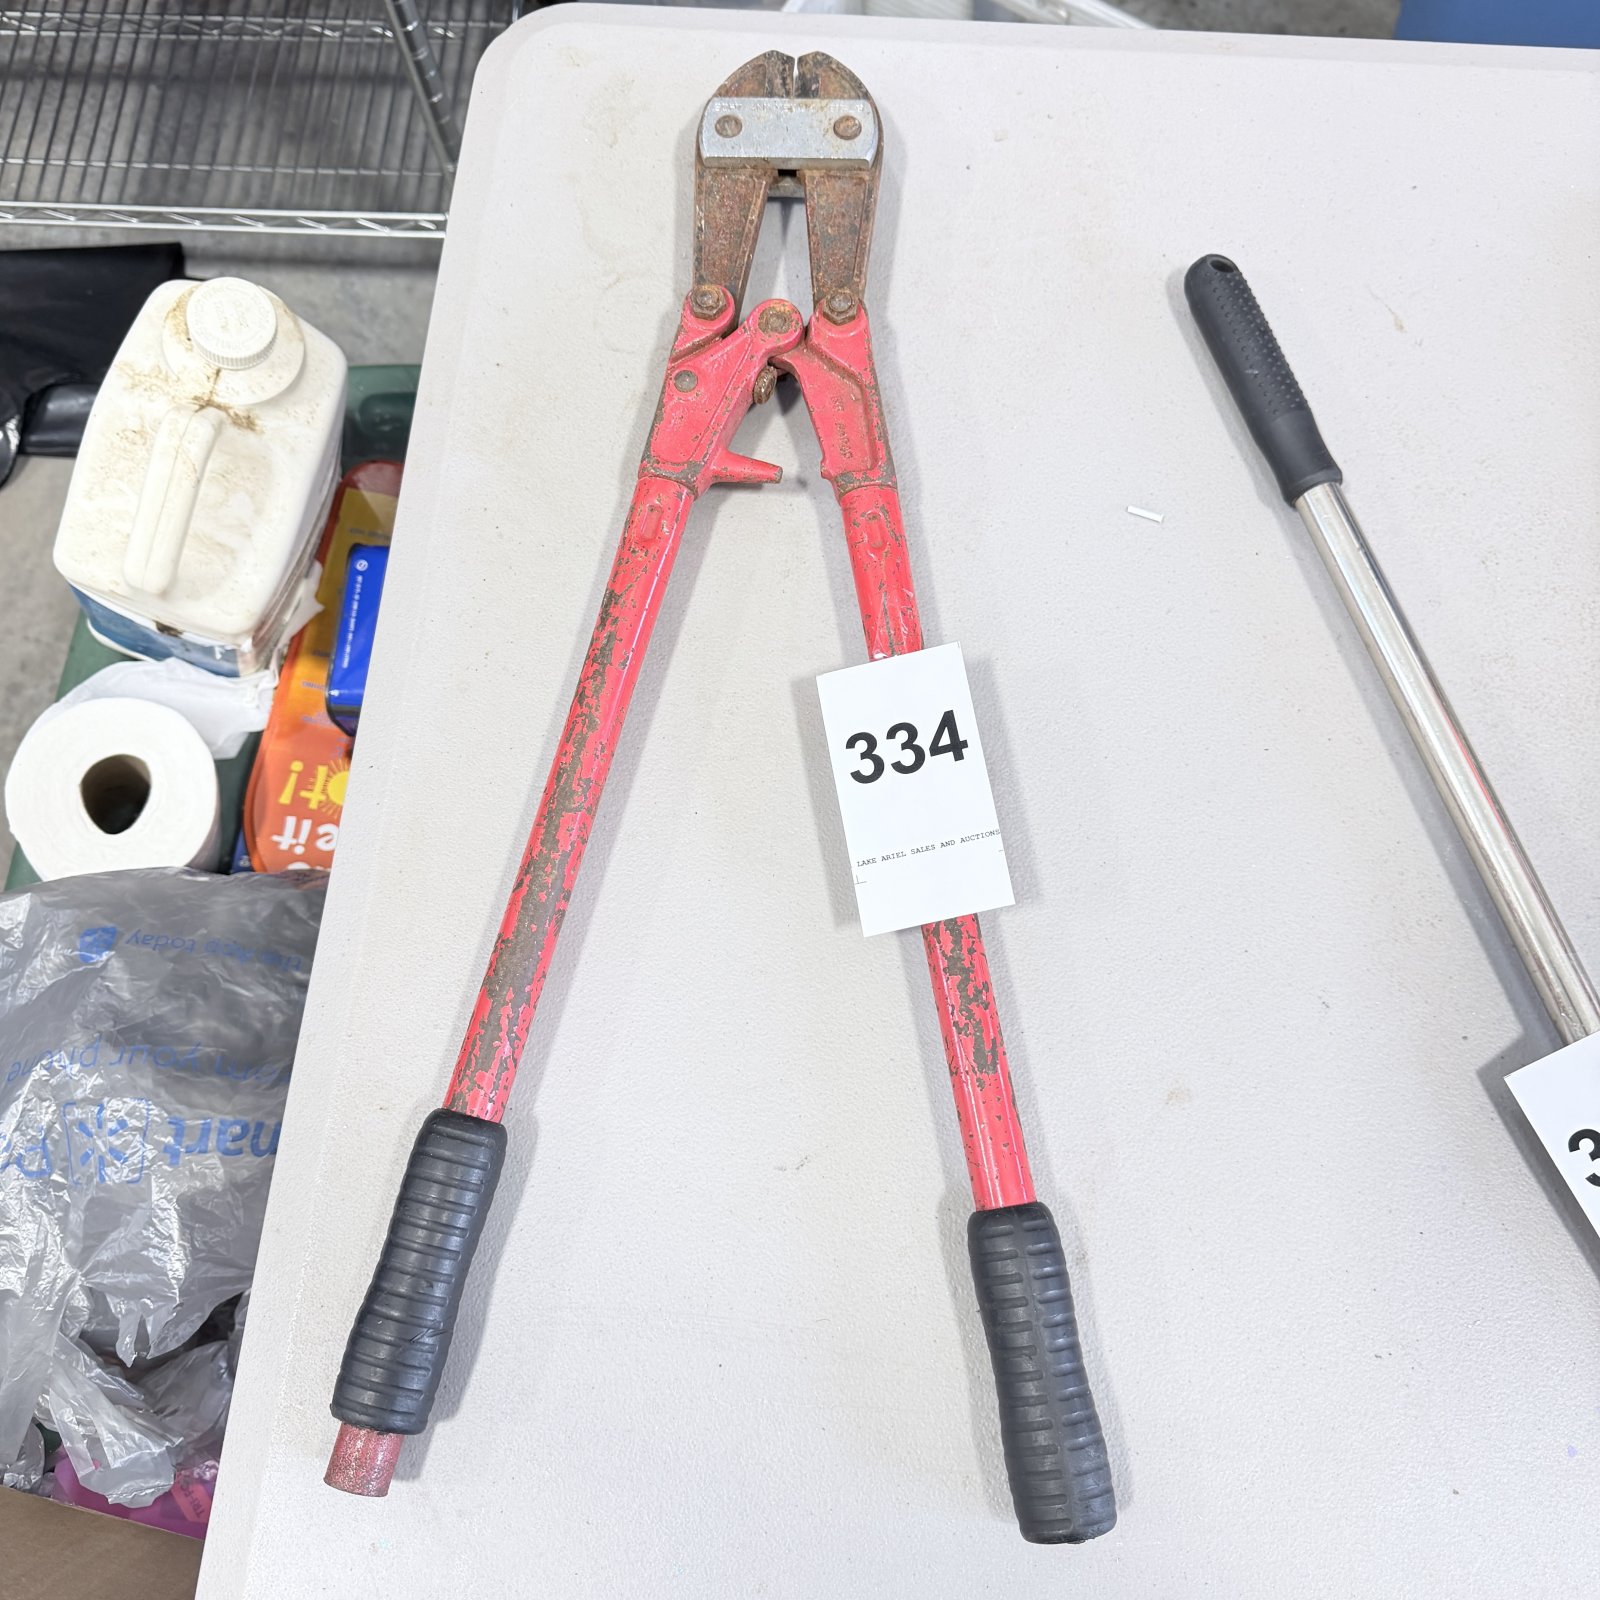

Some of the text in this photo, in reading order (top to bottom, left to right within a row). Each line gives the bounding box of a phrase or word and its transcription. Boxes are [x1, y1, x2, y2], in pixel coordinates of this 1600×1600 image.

[845, 709, 969, 784] 334
[271, 815, 312, 855] it
[856, 828, 1001, 868] LAKE ARIEL SALES AND AUCTIONS
[126, 927, 197, 951] today
[108, 1041, 201, 1068] your
